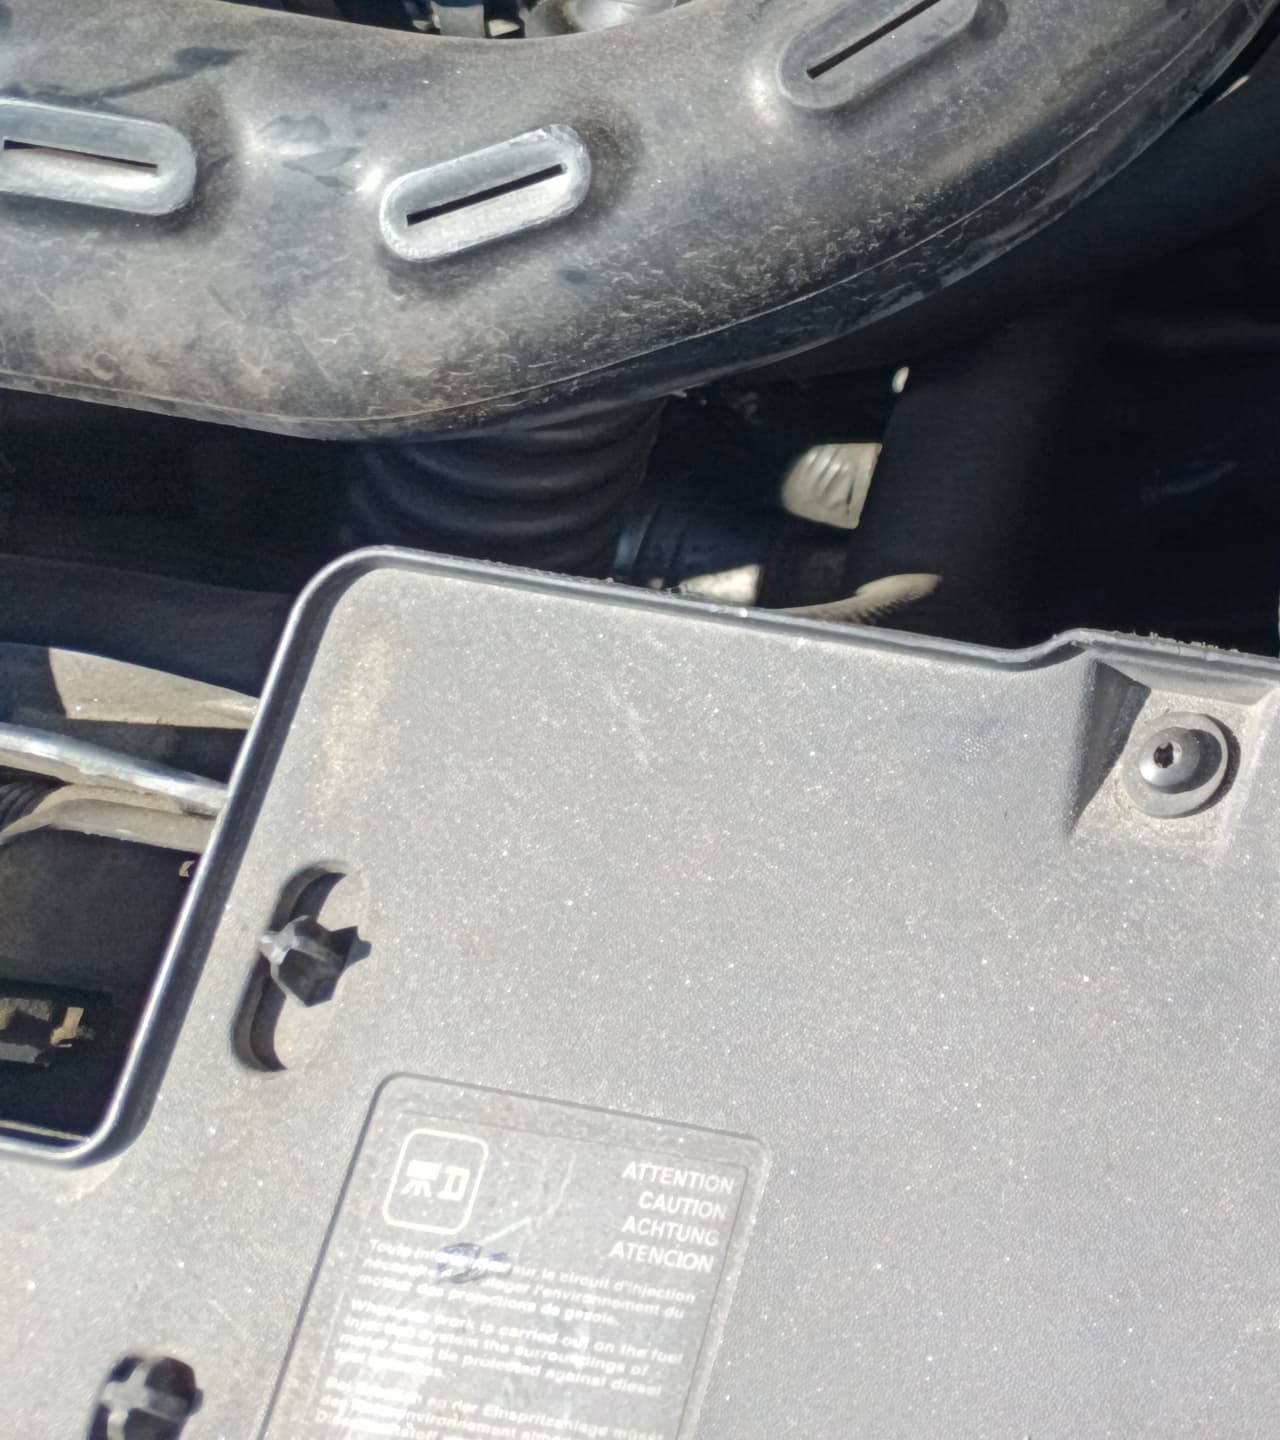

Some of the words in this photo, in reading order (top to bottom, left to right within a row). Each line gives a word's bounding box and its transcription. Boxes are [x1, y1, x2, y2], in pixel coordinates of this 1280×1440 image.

[621, 1161, 734, 1196] ATTENTION
[636, 1190, 728, 1222] CAUTION
[621, 1214, 721, 1248] ACHTUNG
[608, 1239, 714, 1274] ATENCION
